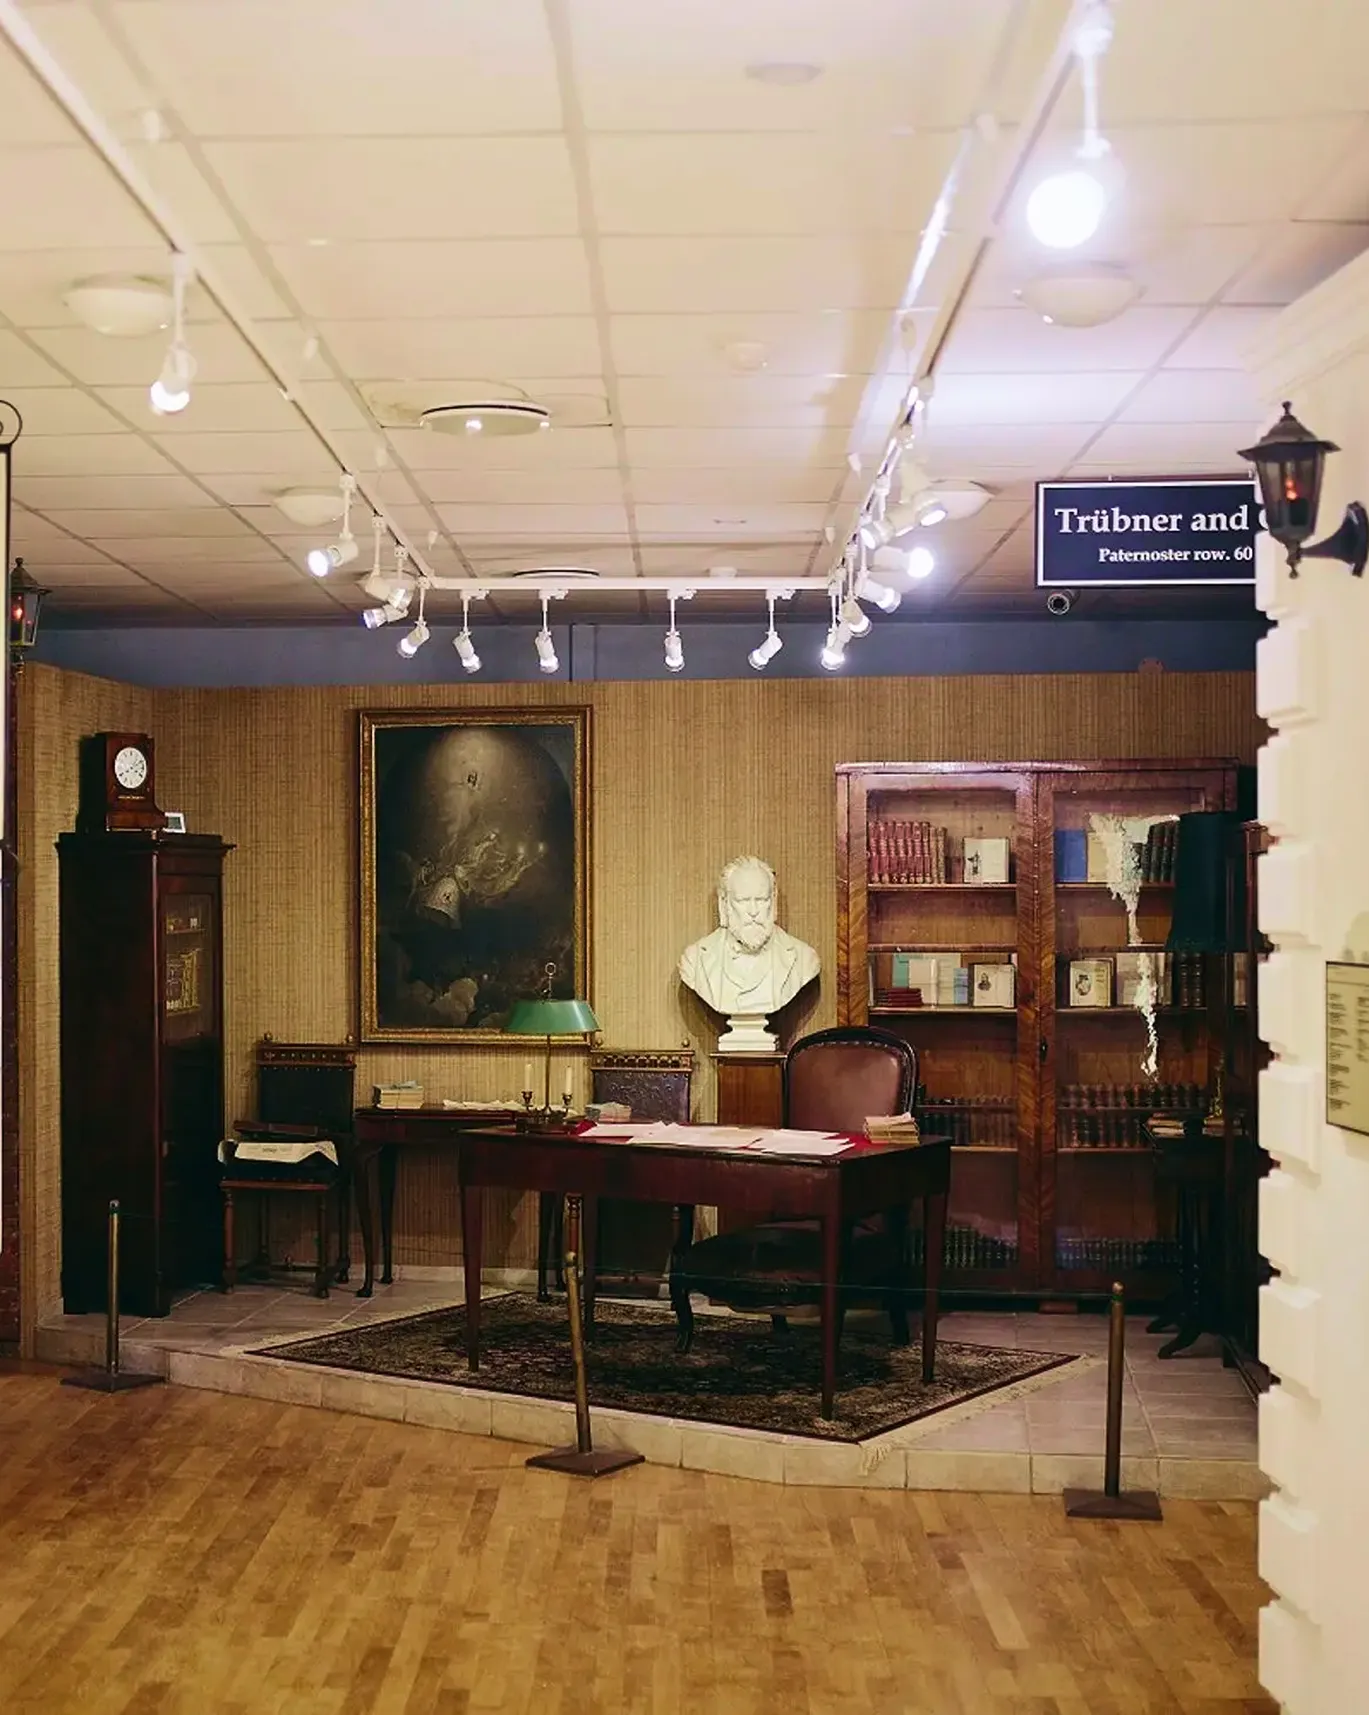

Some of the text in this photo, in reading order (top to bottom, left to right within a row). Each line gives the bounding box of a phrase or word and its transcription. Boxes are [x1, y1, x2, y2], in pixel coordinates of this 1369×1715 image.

[1054, 506, 1183, 533] Trübner
[1190, 504, 1249, 532] and
[1098, 546, 1253, 562] Paternoster row. 60
